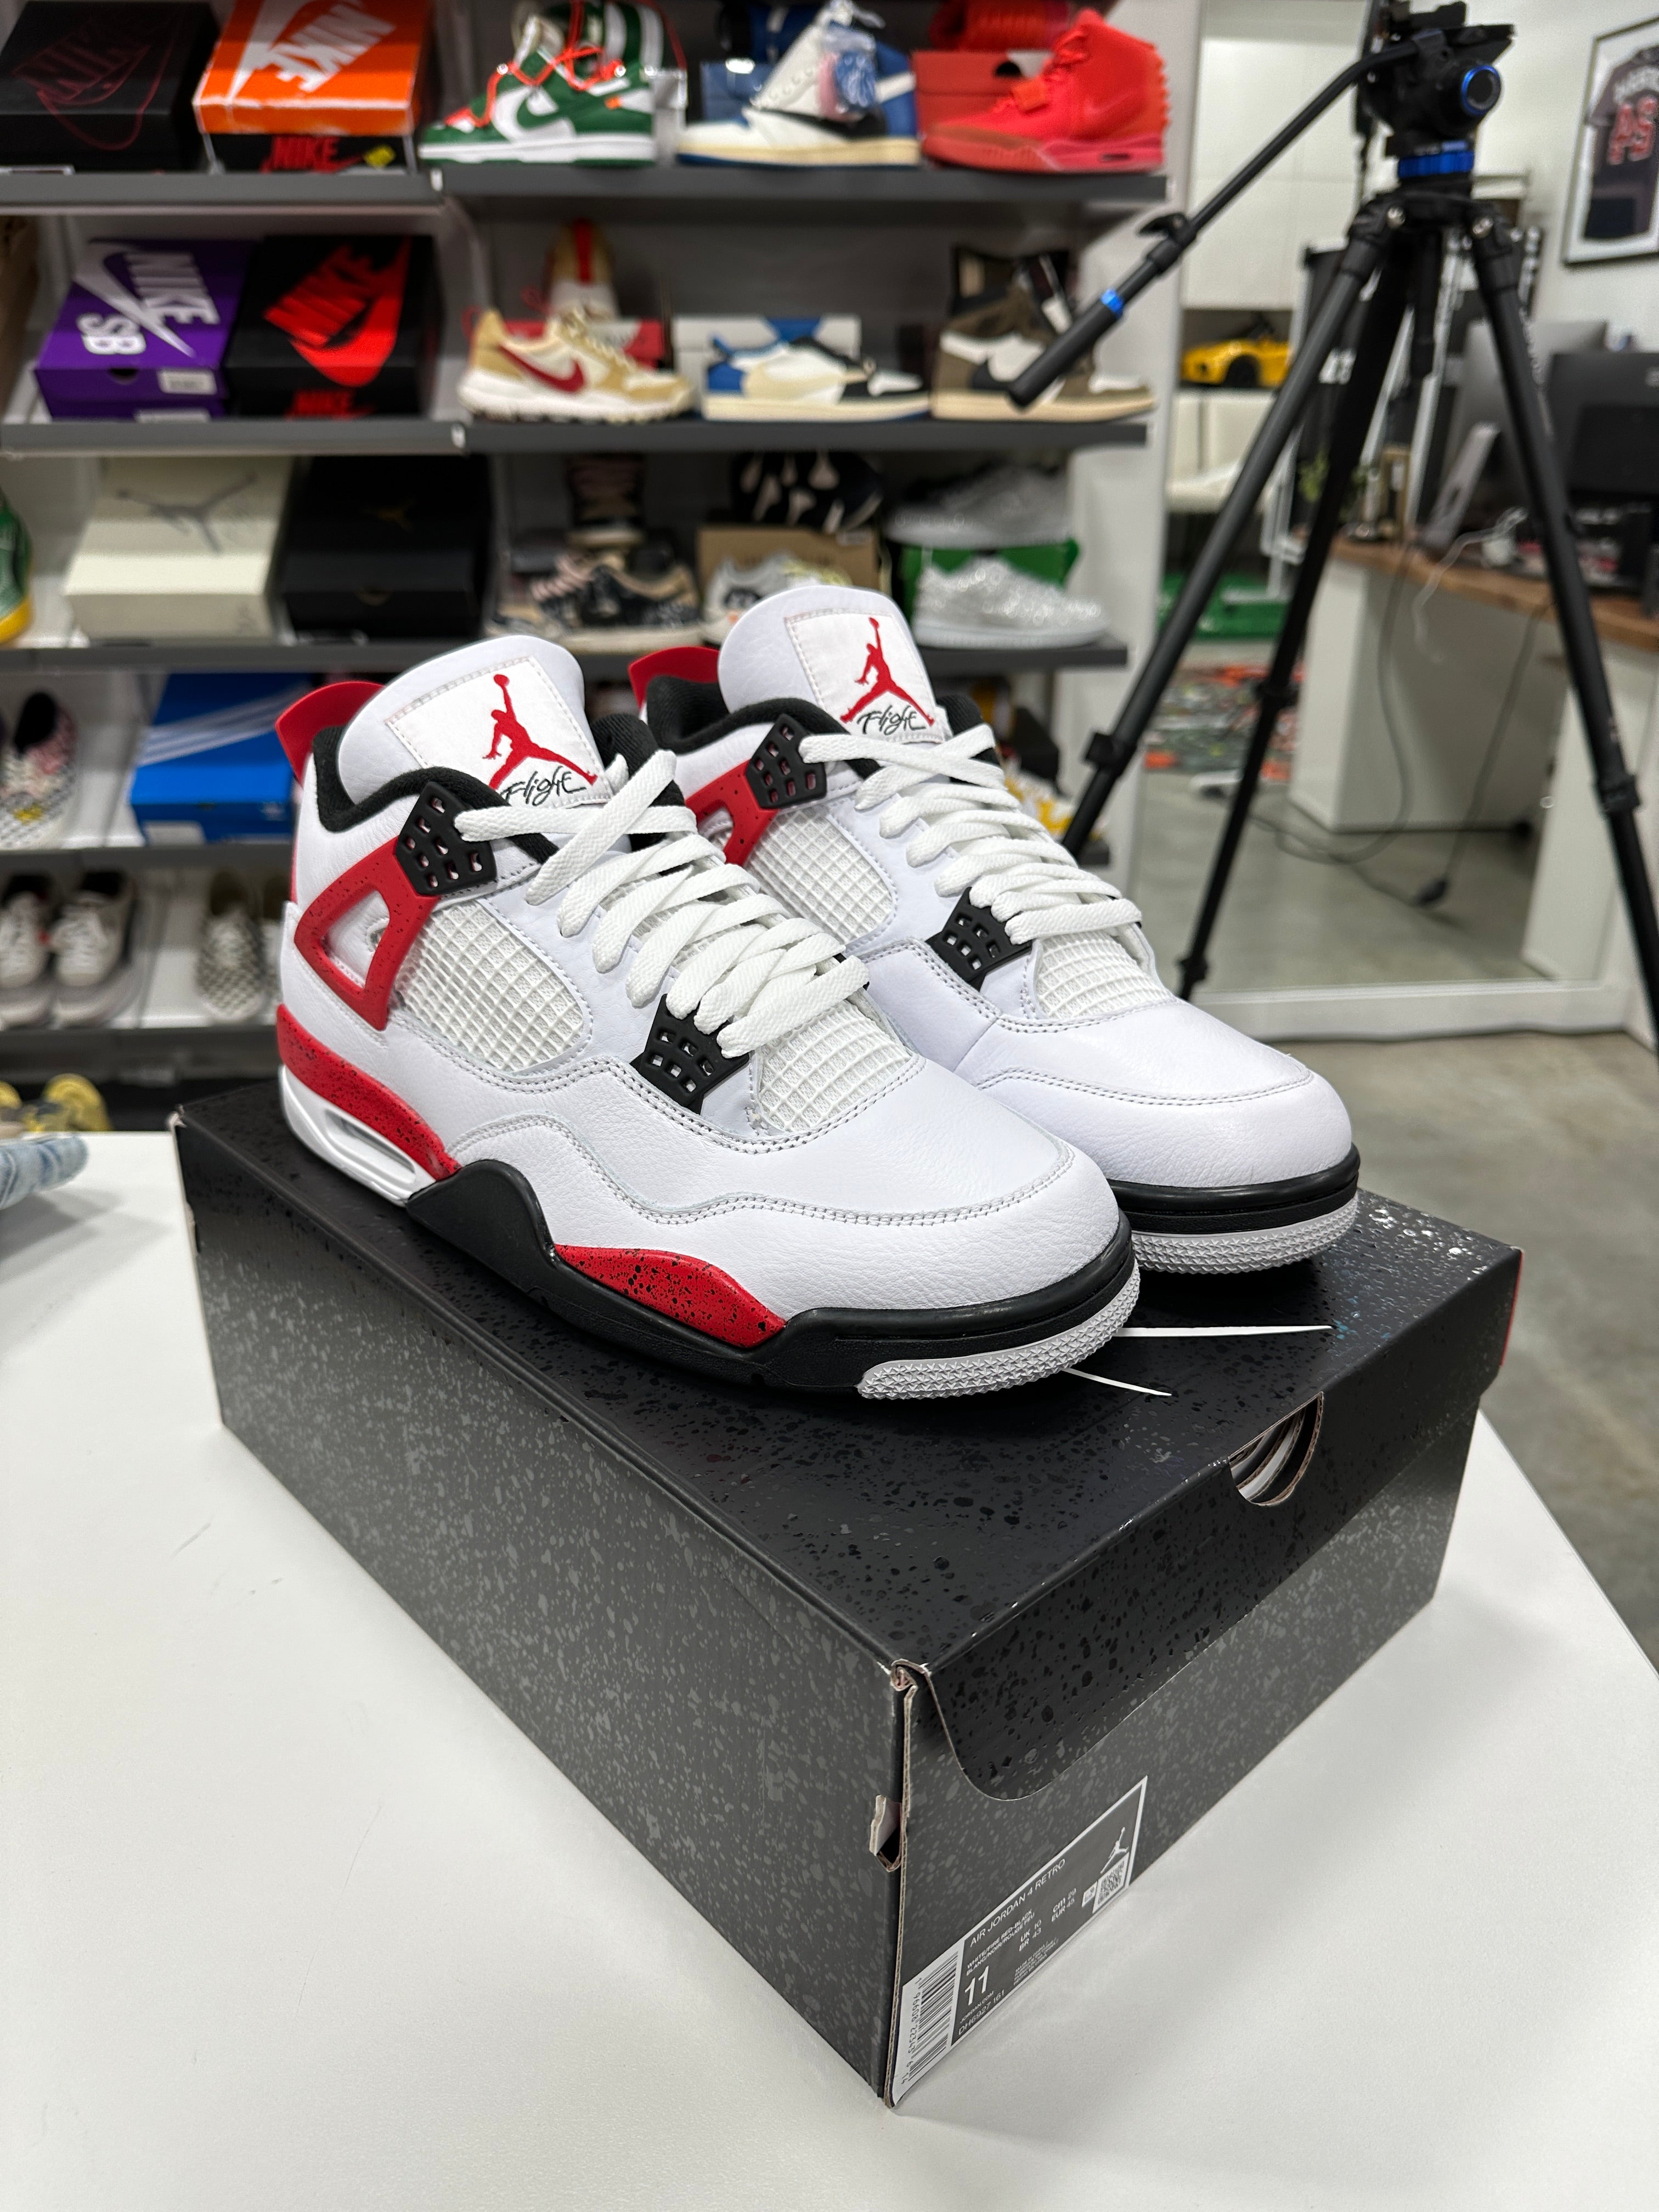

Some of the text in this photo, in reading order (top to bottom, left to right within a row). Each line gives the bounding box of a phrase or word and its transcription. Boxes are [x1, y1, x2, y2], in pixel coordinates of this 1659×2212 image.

[256, 0, 396, 93] NIKE
[272, 134, 340, 170] NIKE
[123, 253, 220, 325] NIKE
[263, 245, 387, 348] NIKE
[76, 312, 146, 355] SB
[856, 704, 926, 736] Flight
[500, 766, 586, 807] Flight
[970, 1858, 1065, 1948] AIR JORDAN 4 RETRO
[1052, 1906, 1066, 1922] EUR
[1053, 1898, 1066, 1913] cm
[1019, 1927, 1041, 1951] BR 43
[1020, 1919, 1042, 1942] UK 10
[964, 1965, 989, 2006] 11
[911, 1992, 921, 2023] 96608
[958, 1989, 1005, 2035] DH6927 161
[960, 1990, 994, 2024] JORDAN.COM
[908, 2024, 917, 2053] 22343
